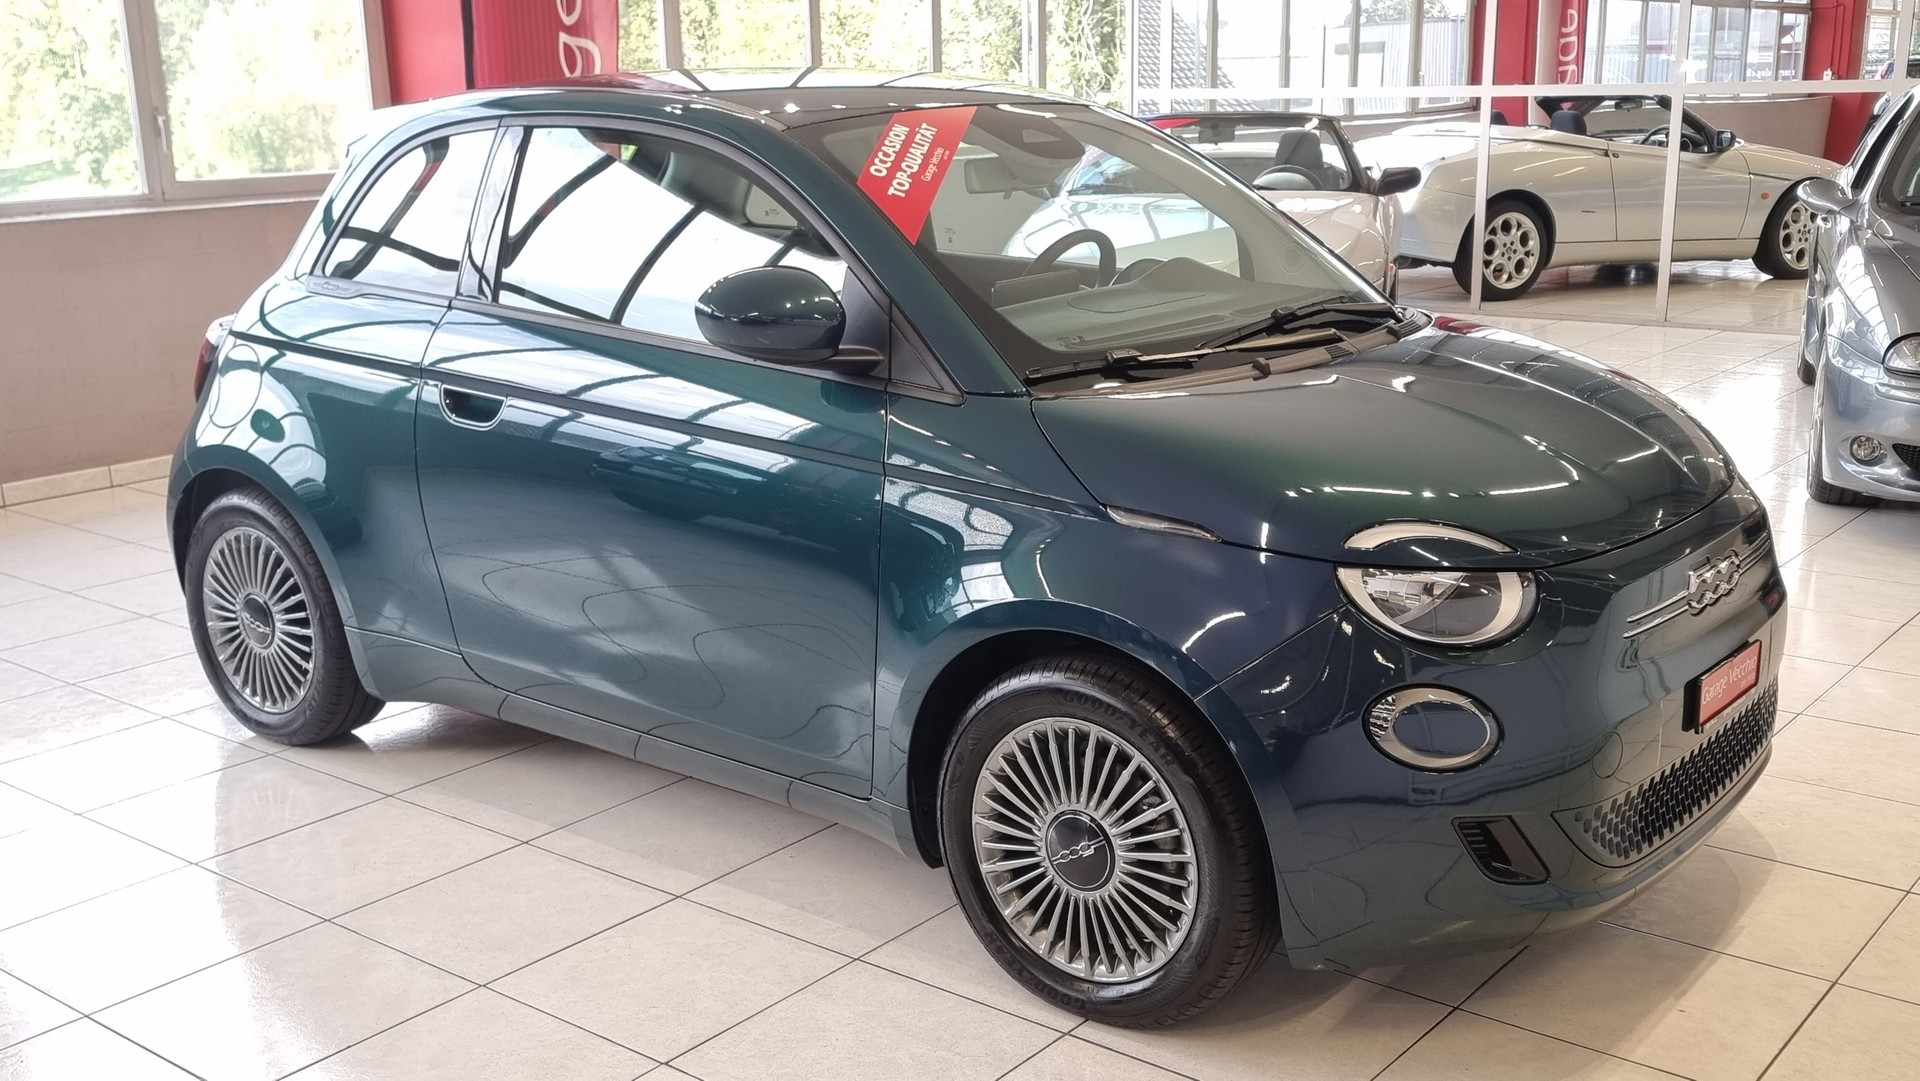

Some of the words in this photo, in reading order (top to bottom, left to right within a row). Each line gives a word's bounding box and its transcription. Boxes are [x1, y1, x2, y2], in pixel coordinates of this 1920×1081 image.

[869, 123, 911, 177] OCCASION
[887, 122, 938, 198] TOP-QUALITÄT
[921, 163, 938, 182] Garage
[929, 147, 945, 165] Vecchio
[1702, 676, 1728, 705] Garage
[1729, 655, 1758, 684] Vecchio
[1062, 690, 1177, 768] GOODYEAR
